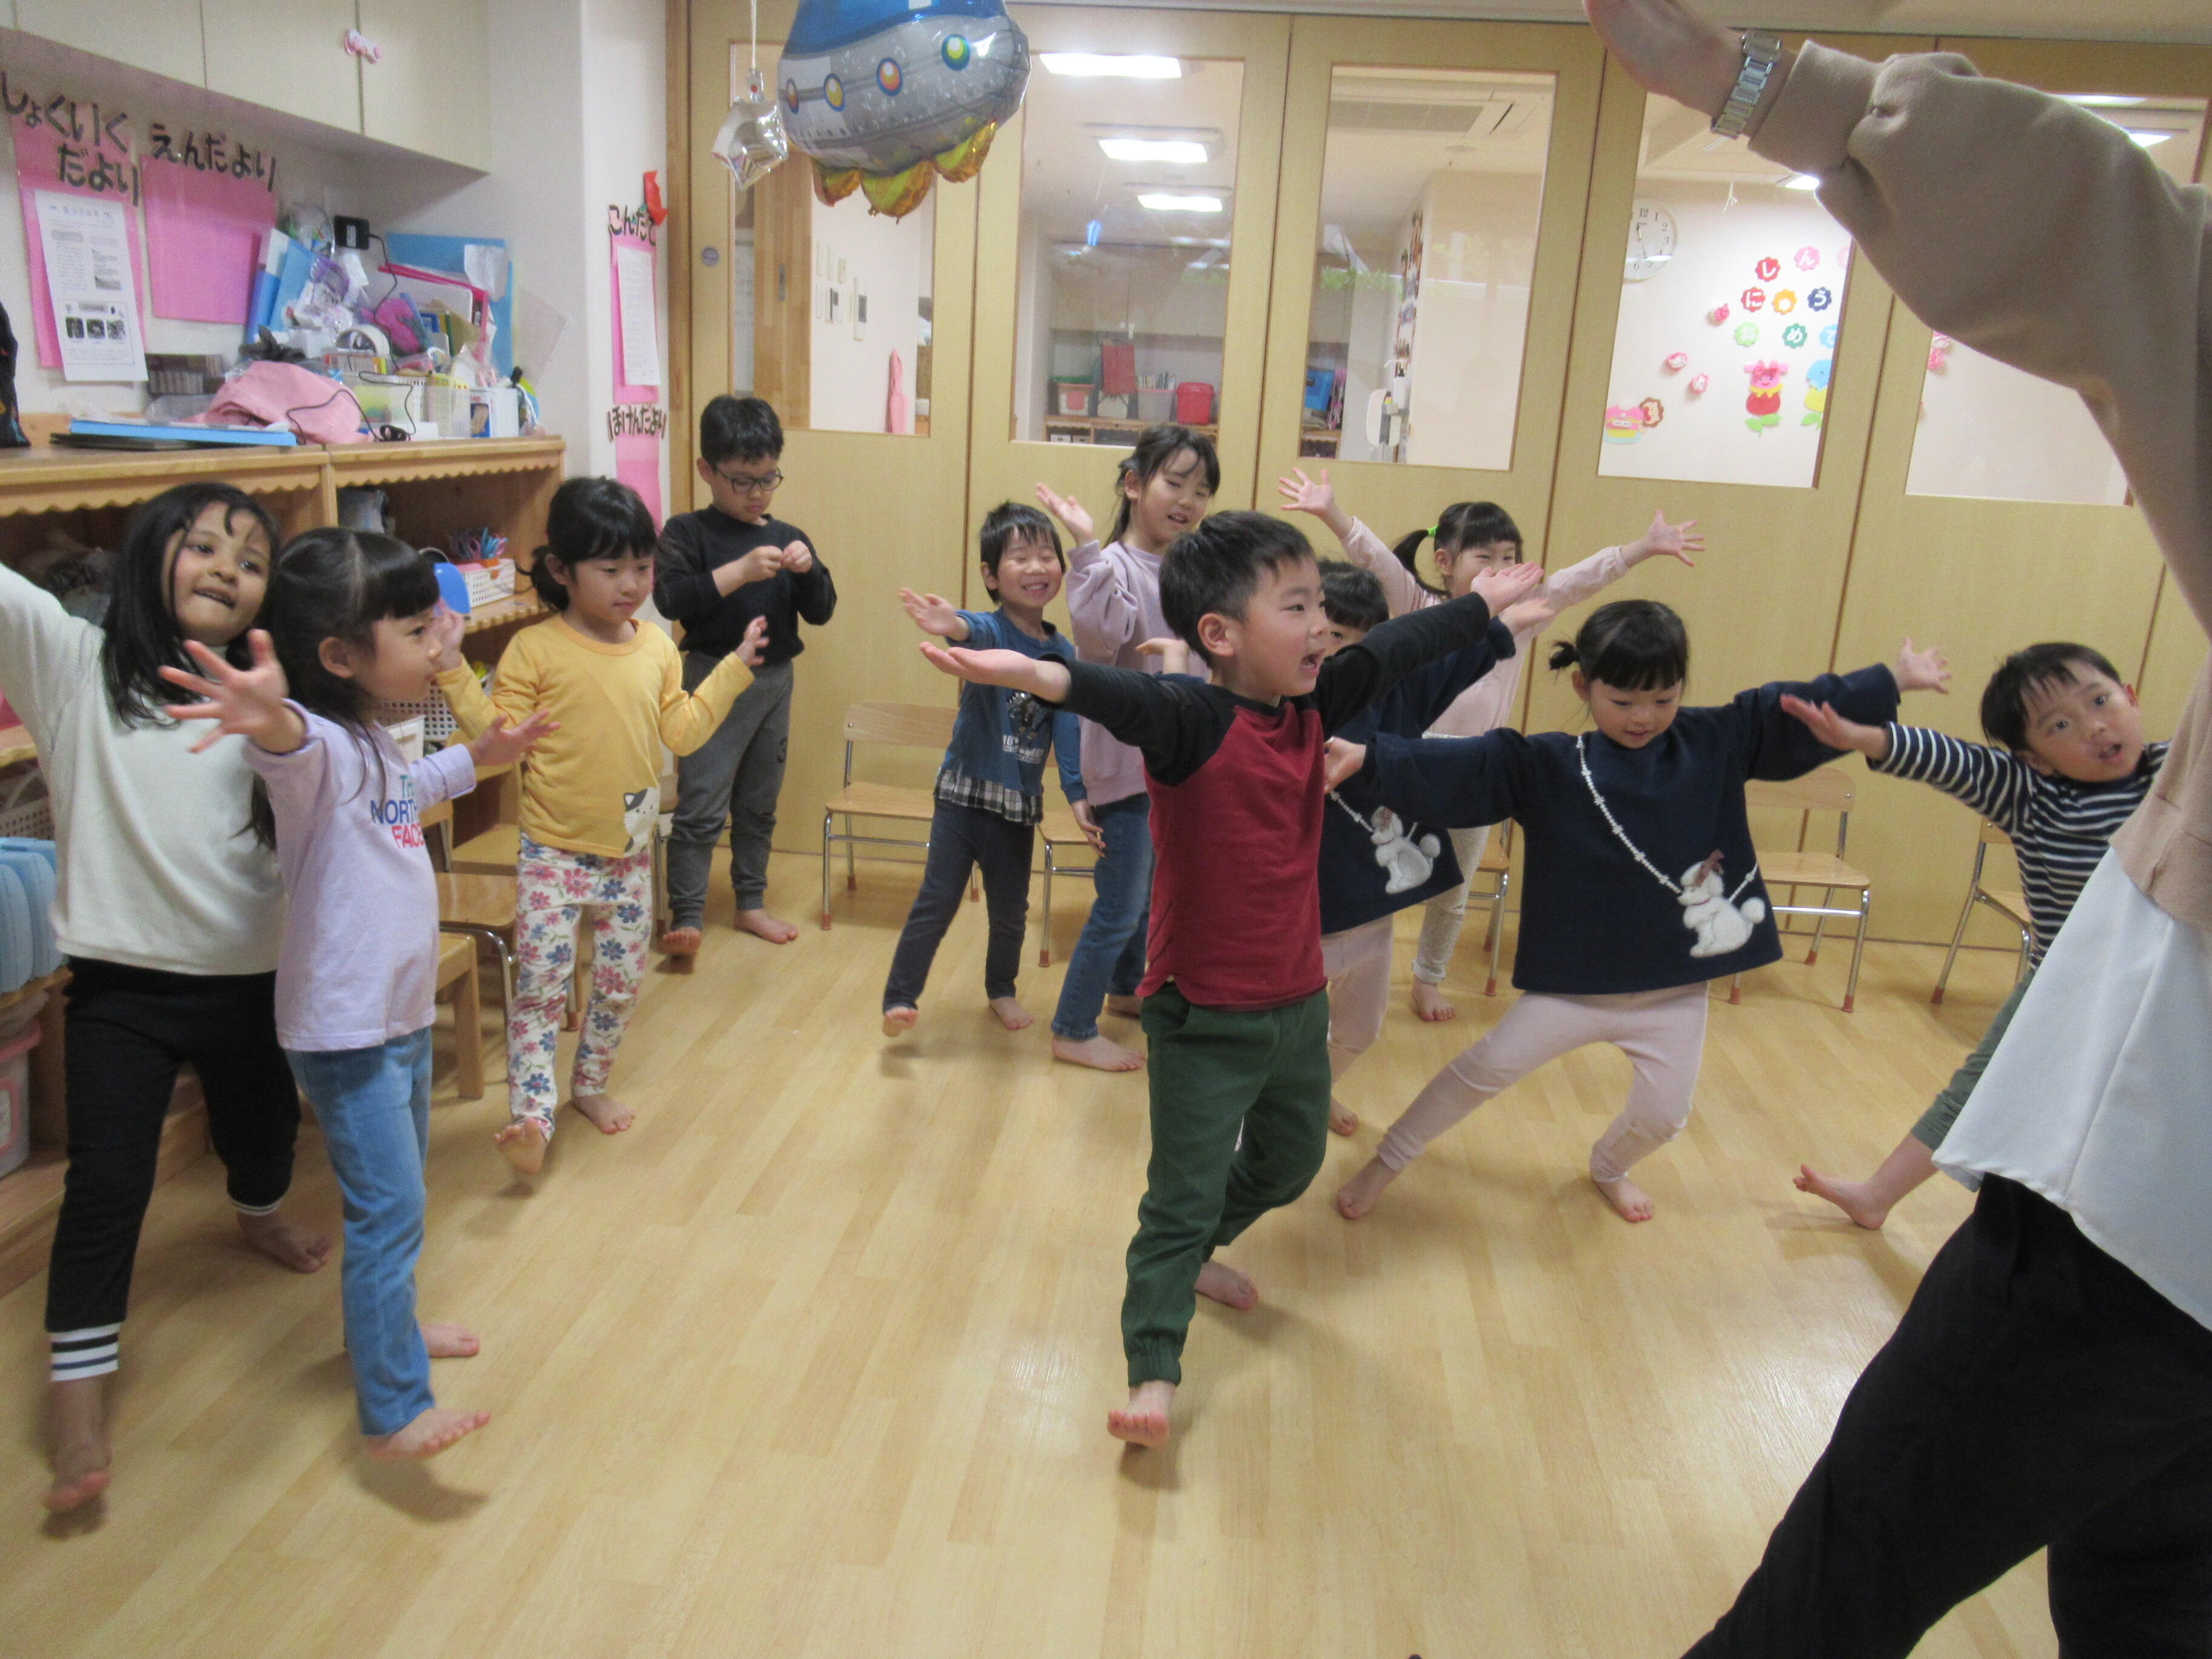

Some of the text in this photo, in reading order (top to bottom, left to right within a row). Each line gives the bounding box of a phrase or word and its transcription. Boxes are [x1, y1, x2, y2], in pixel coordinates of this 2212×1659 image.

[1, 71, 128, 153] しょくいく
[152, 122, 276, 192] えんだより
